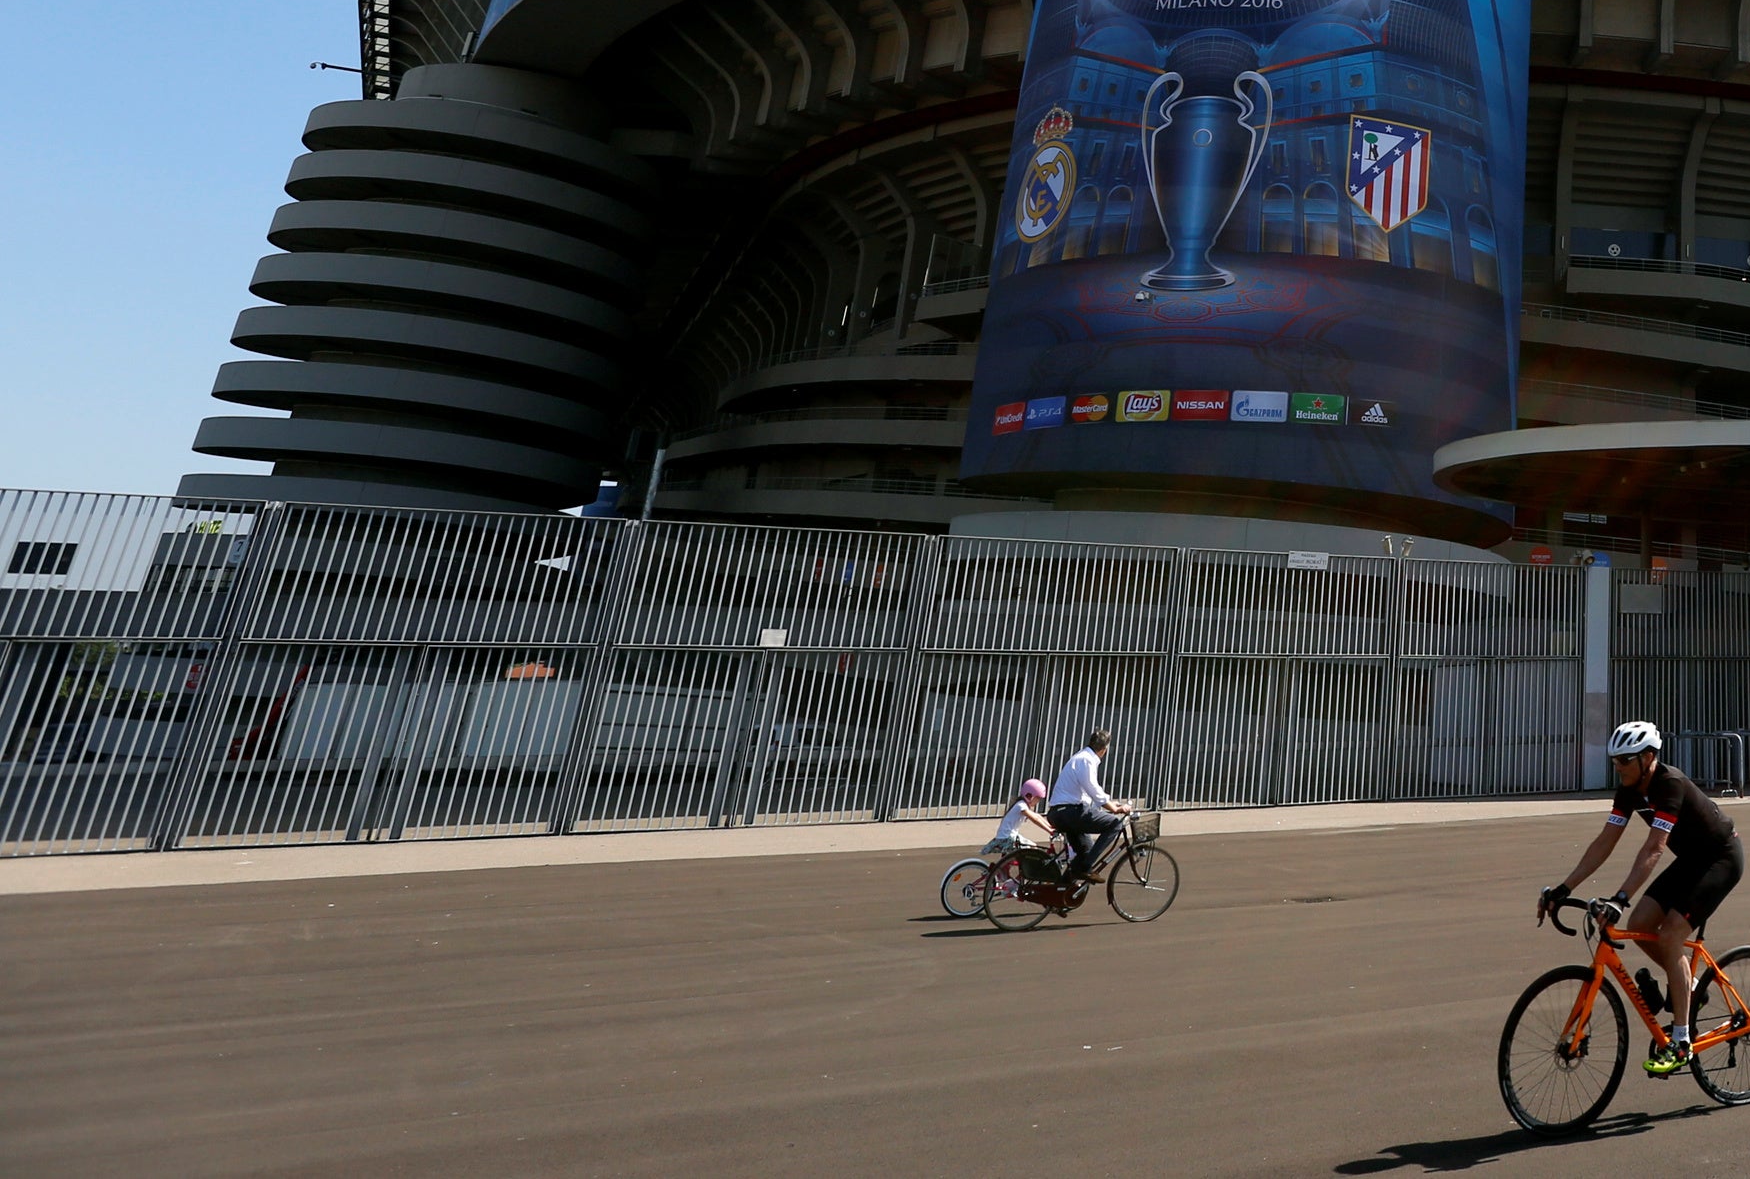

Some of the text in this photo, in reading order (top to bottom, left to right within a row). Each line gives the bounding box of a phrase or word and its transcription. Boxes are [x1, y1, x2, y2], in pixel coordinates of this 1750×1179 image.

[1126, 394, 1160, 413] Lay's
[1176, 401, 1225, 410] NISSAN
[1038, 407, 1062, 417] PS4
[1071, 404, 1109, 414] MasterCard
[1249, 409, 1282, 418] GAZPROM
[1296, 410, 1339, 421] Heineken
[1361, 415, 1388, 424] adidas
